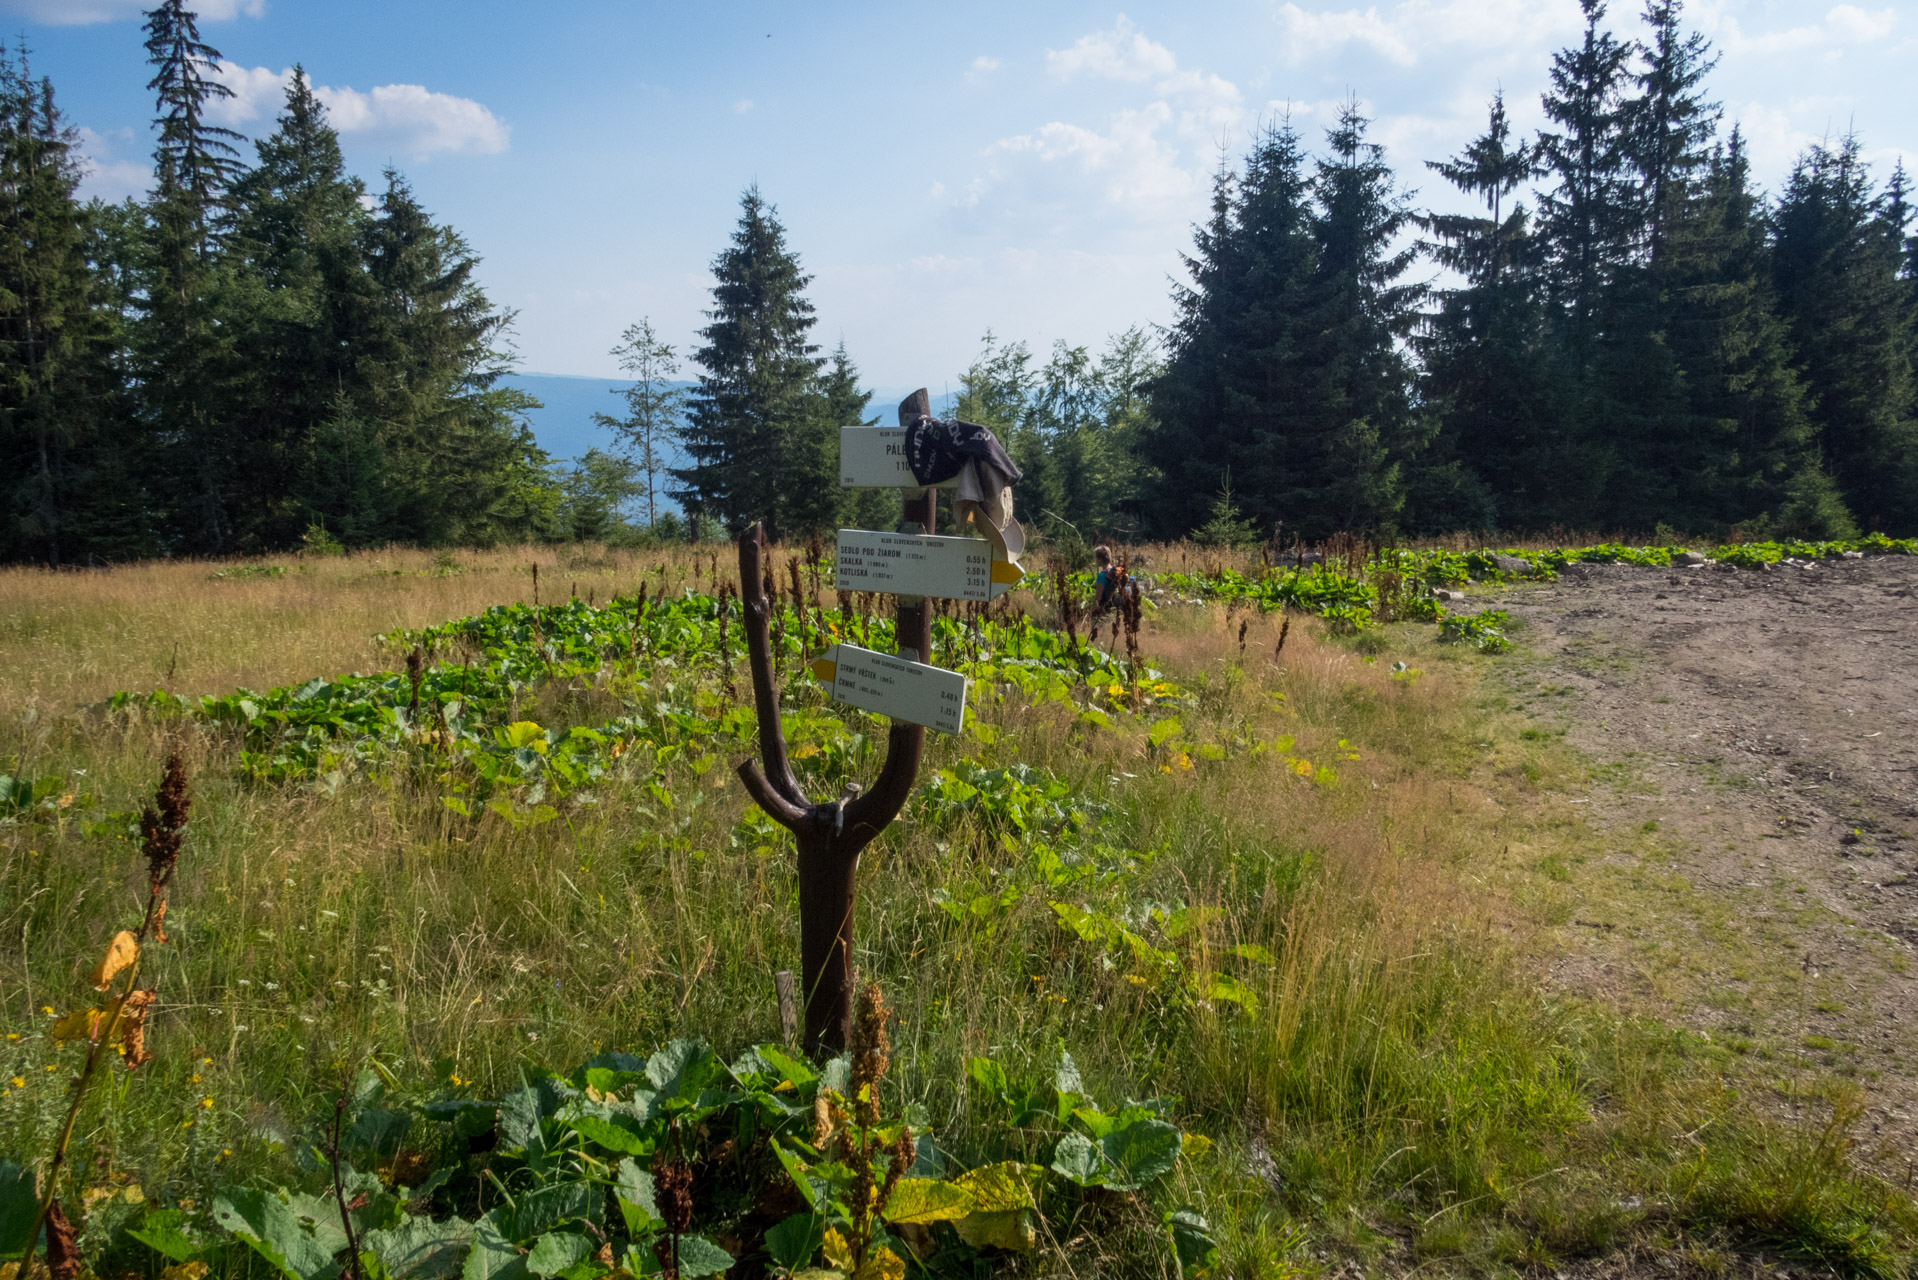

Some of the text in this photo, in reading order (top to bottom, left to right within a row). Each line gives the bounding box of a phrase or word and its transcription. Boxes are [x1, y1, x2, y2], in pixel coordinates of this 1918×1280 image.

[886, 442, 907, 455] PÁLE
[896, 461, 910, 471] 110
[840, 546, 859, 555] SEDLO
[862, 547, 875, 556] POD
[877, 548, 901, 558] ŽIAROM
[840, 557, 863, 566] SKALKA
[840, 567, 868, 577] KOTLISKÁ
[840, 663, 856, 674] STRMÝ
